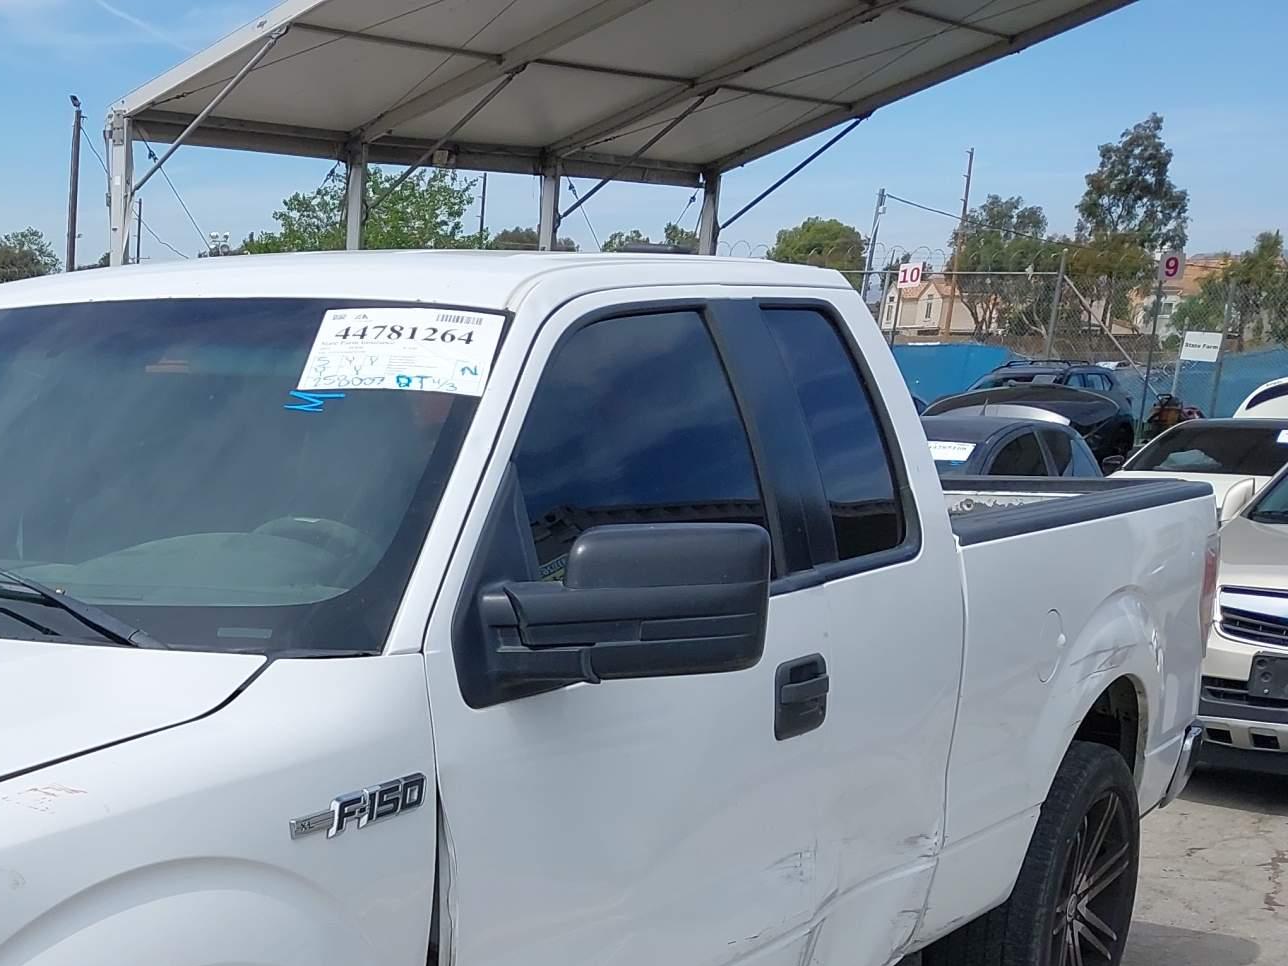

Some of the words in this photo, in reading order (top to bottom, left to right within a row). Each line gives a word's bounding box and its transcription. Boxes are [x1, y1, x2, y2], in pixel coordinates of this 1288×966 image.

[899, 265, 922, 284] 10
[1164, 256, 1180, 278] 9
[334, 323, 475, 346] 44781264
[327, 770, 427, 840] F-150
